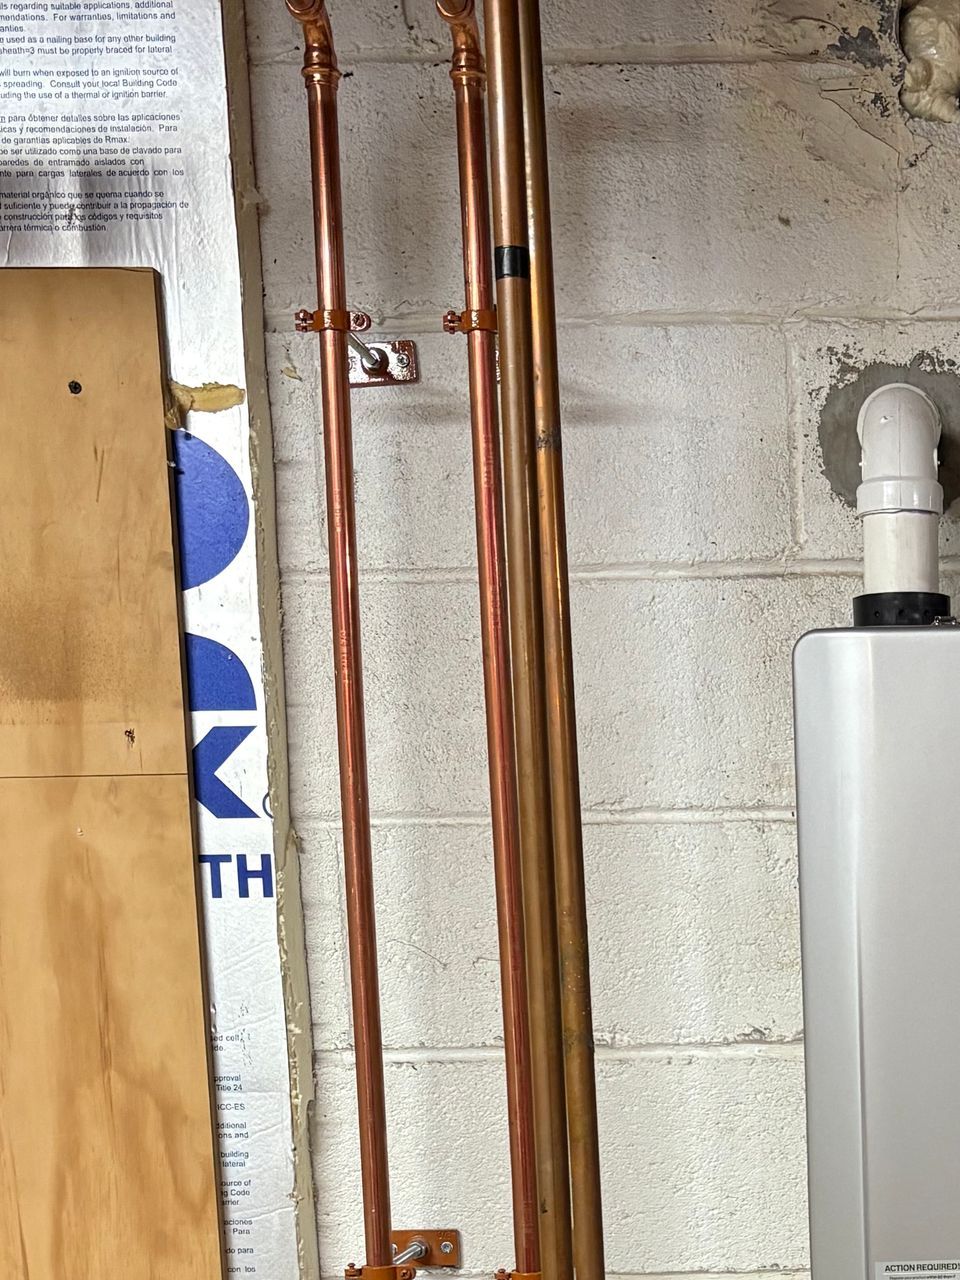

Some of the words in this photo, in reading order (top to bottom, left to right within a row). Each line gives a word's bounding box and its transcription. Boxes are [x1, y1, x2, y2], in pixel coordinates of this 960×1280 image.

[51, 2, 81, 10] suitable
[53, 13, 67, 21] For
[46, 36, 72, 47] nailing
[95, 34, 105, 43] for
[146, 34, 176, 44] building
[72, 47, 103, 56] properly
[56, 69, 89, 78] exposed
[113, 68, 140, 79] ignition
[143, 67, 168, 75] source
[50, 80, 80, 88] Consult
[122, 79, 154, 88] Building
[220, 1150, 249, 1159] building
[221, 1159, 245, 1168] lateral
[916, 1263, 960, 1271] REQUIRED!
